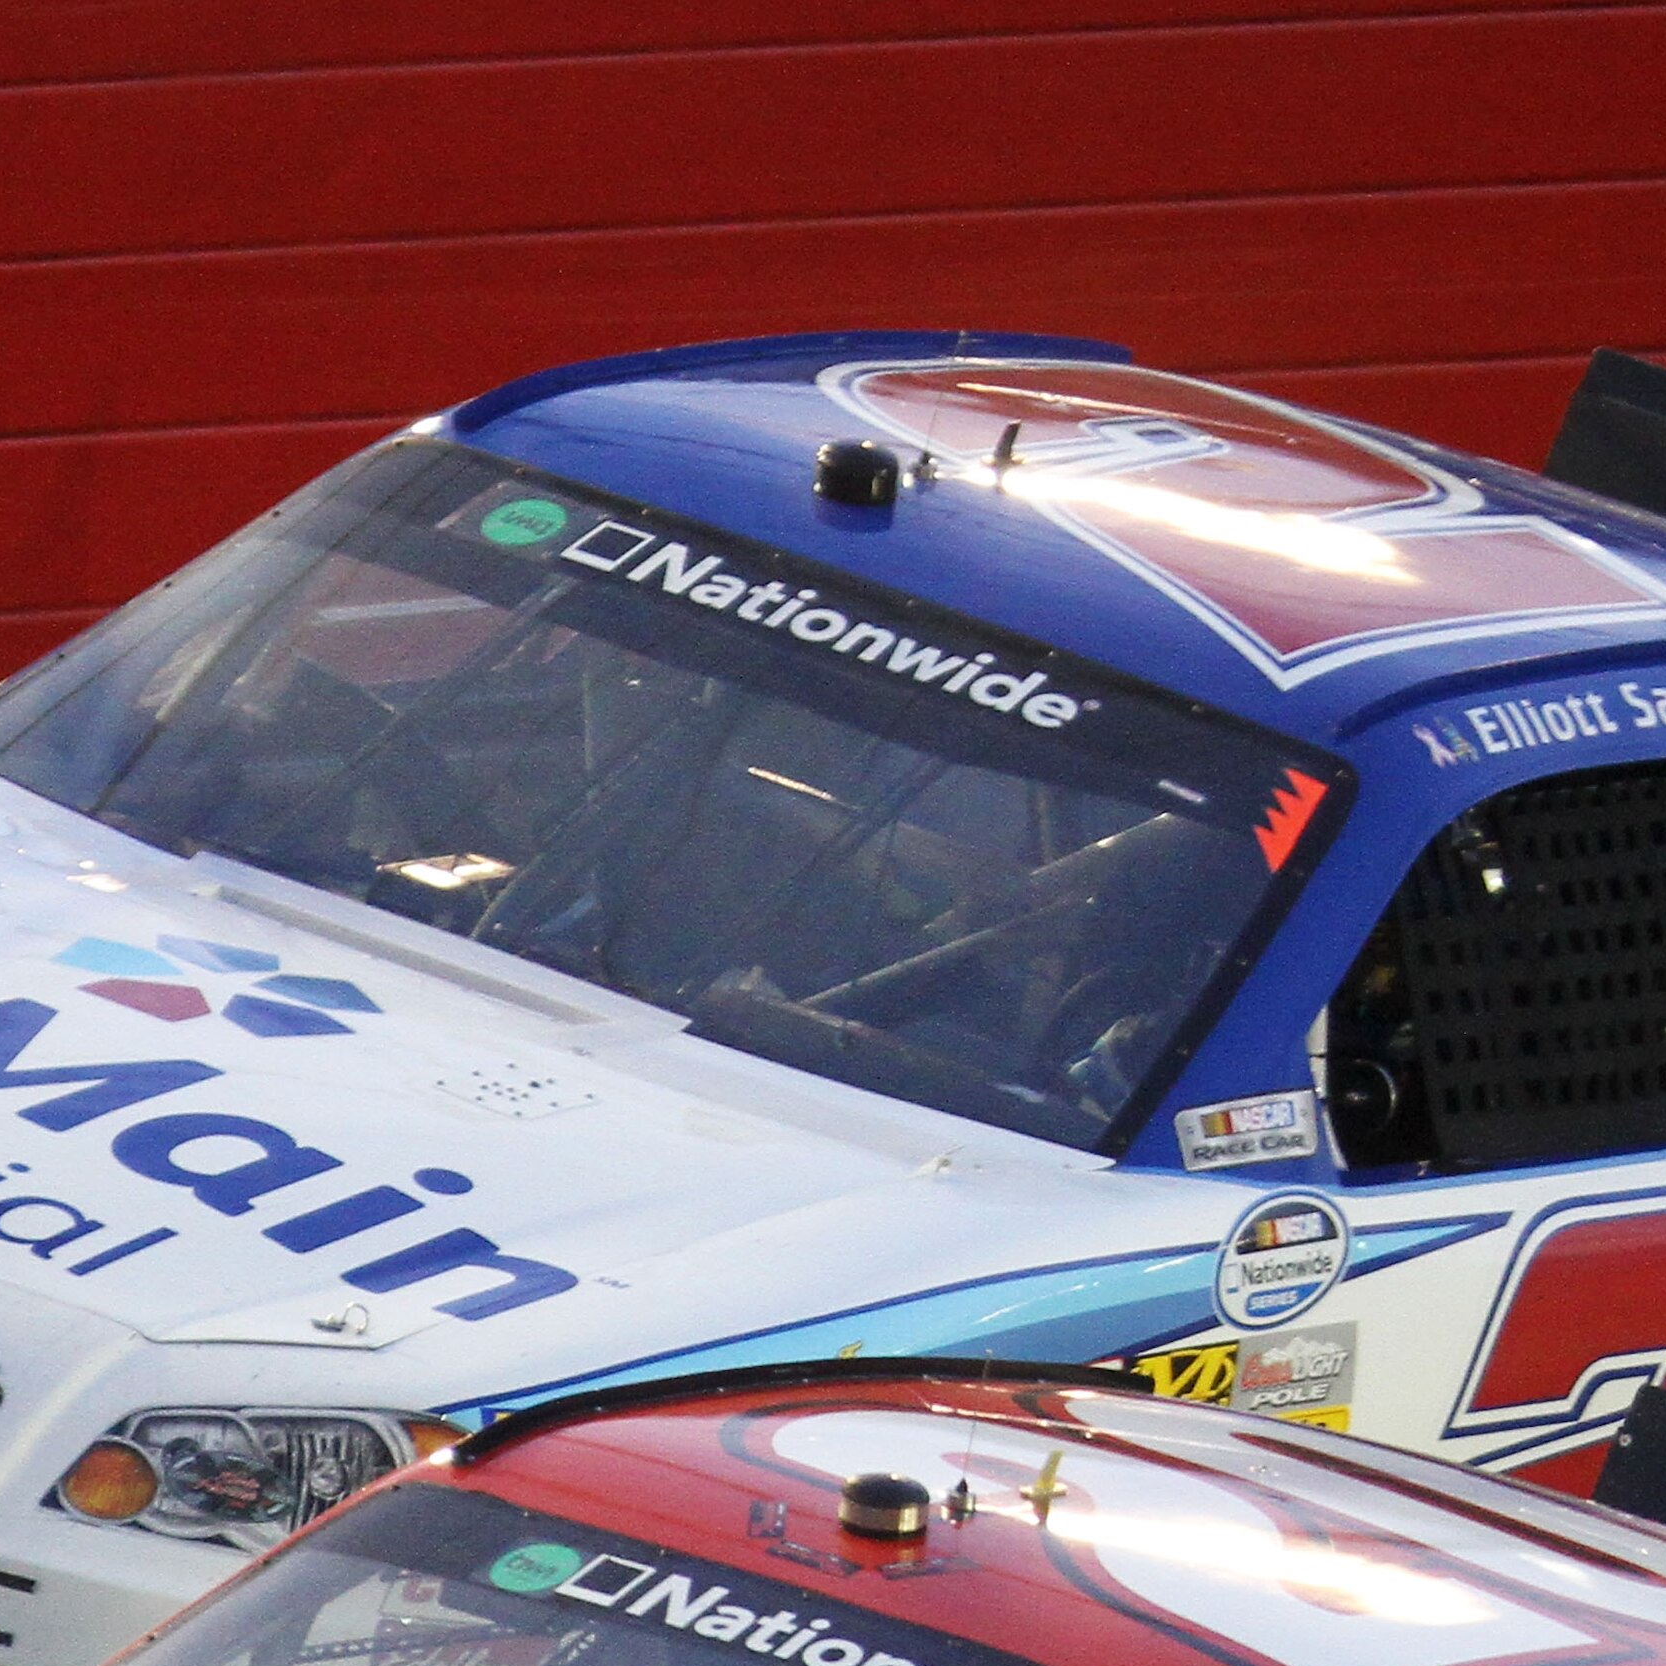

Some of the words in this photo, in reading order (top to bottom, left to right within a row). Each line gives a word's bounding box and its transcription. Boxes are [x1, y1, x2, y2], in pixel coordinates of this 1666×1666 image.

[626, 542, 1079, 729] Nationwide
[1464, 691, 1618, 754] Elliott
[1193, 1139, 1256, 1161] RACE
[1260, 1133, 1305, 1150] CAR
[1241, 1252, 1333, 1286] Nationwide
[1292, 1352, 1349, 1381] LIGHT
[1250, 1382, 1331, 1410] POLE
